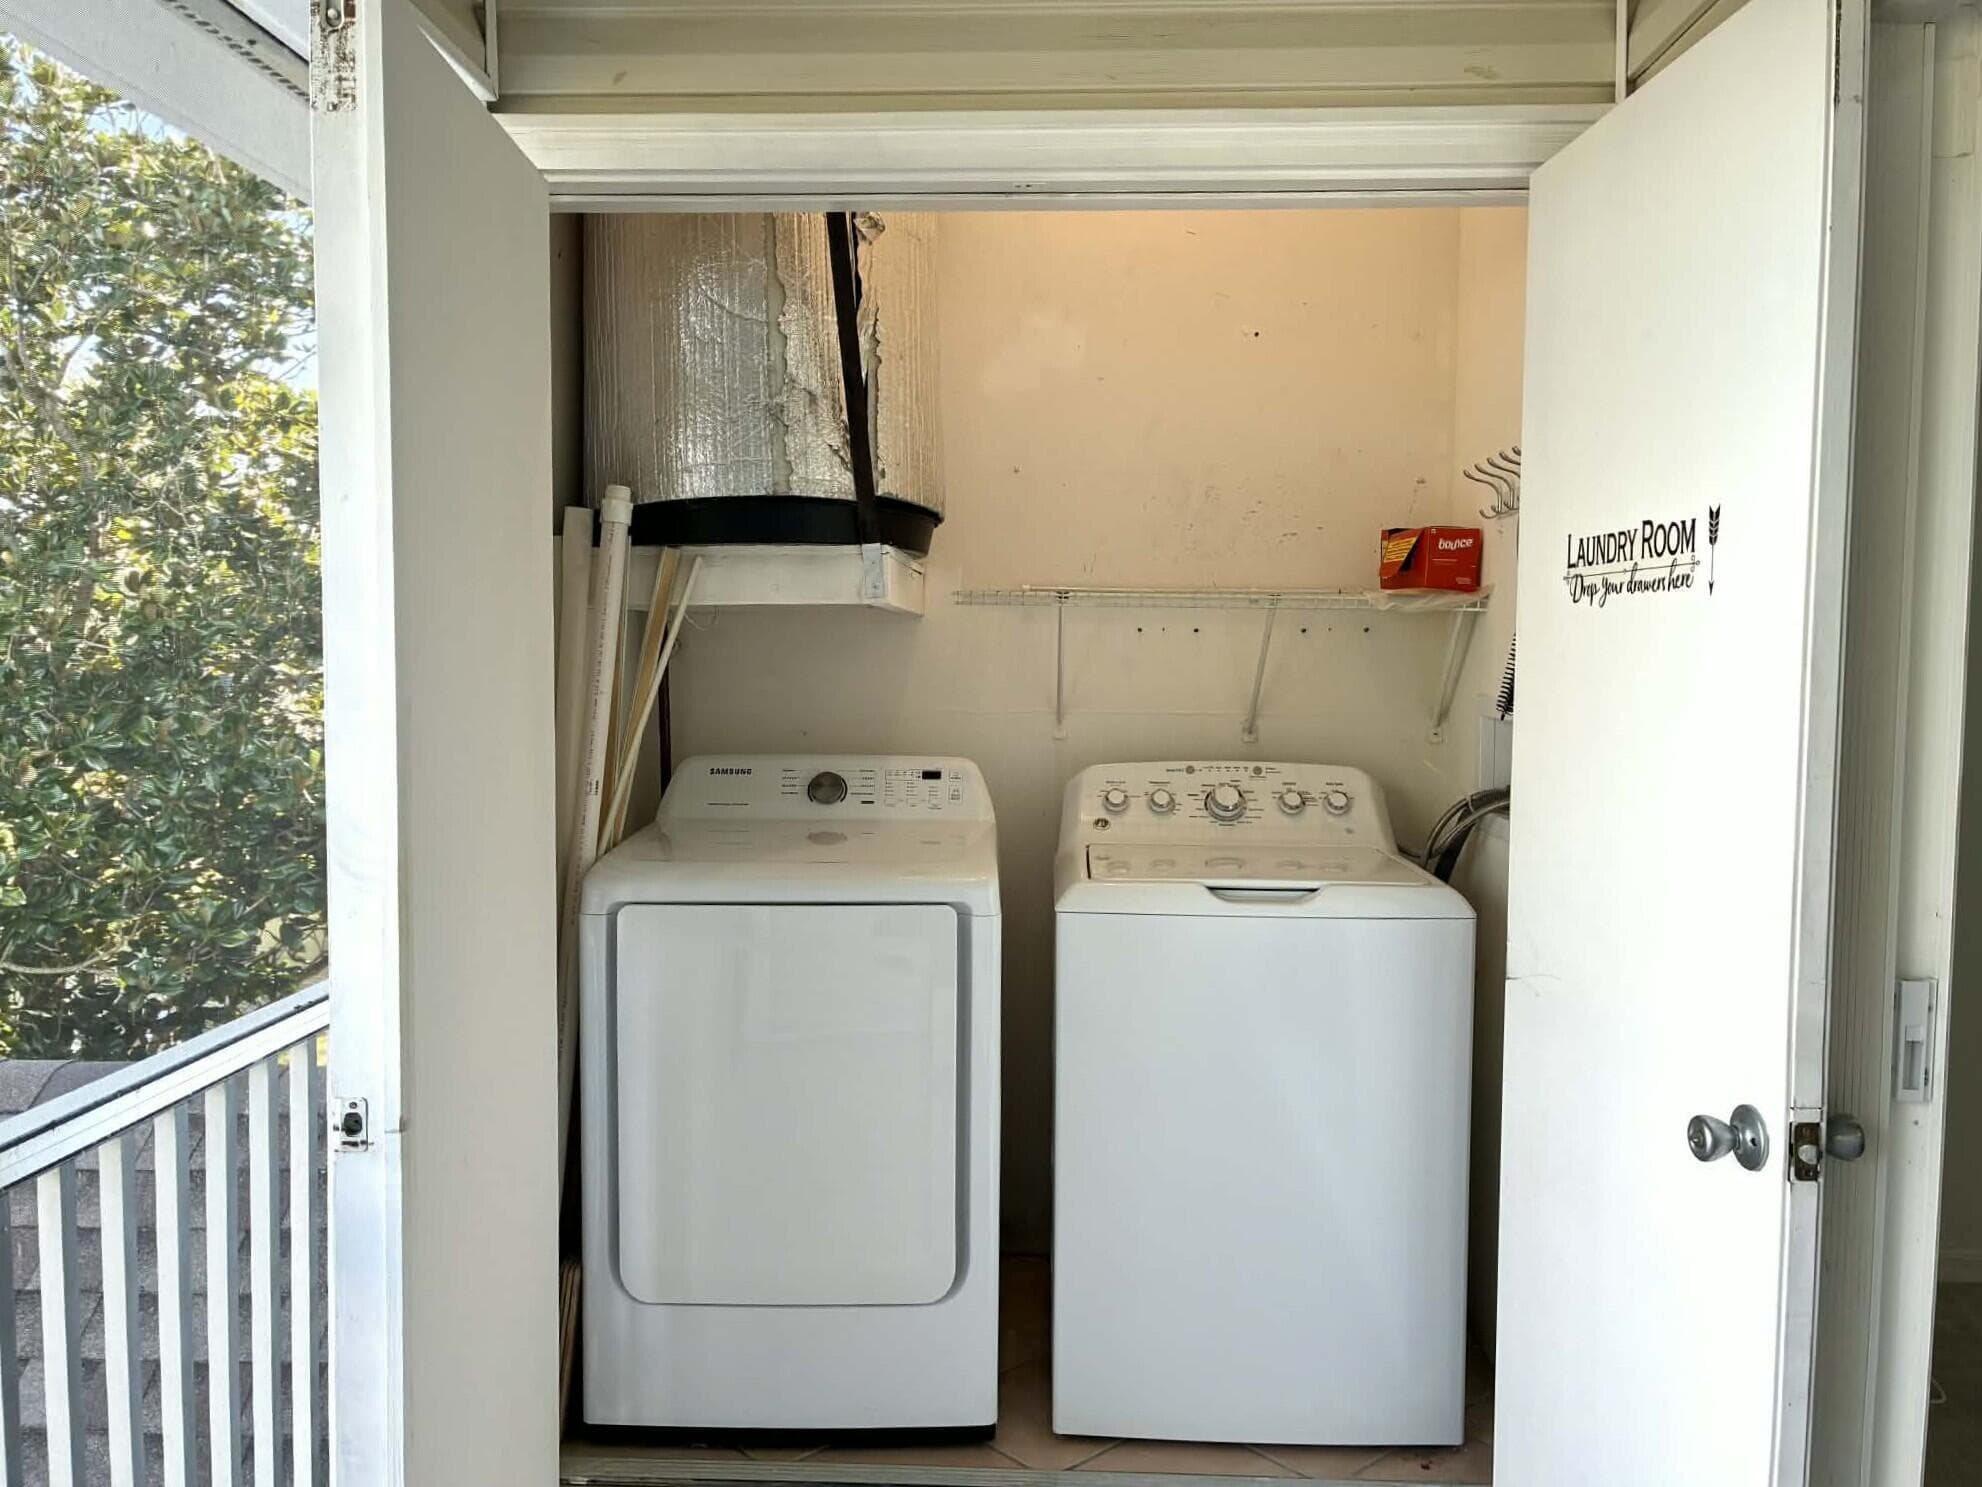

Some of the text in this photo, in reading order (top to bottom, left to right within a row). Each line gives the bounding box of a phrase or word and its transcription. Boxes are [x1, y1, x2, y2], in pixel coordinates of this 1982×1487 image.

[1438, 538, 1473, 551] bounce
[1567, 518, 1696, 569] LAUNDRY ROOM
[1569, 573, 1600, 607] Drop
[1626, 562, 1666, 594] drawers
[1667, 558, 1695, 592] here
[709, 767, 752, 775] SAMSUNG
